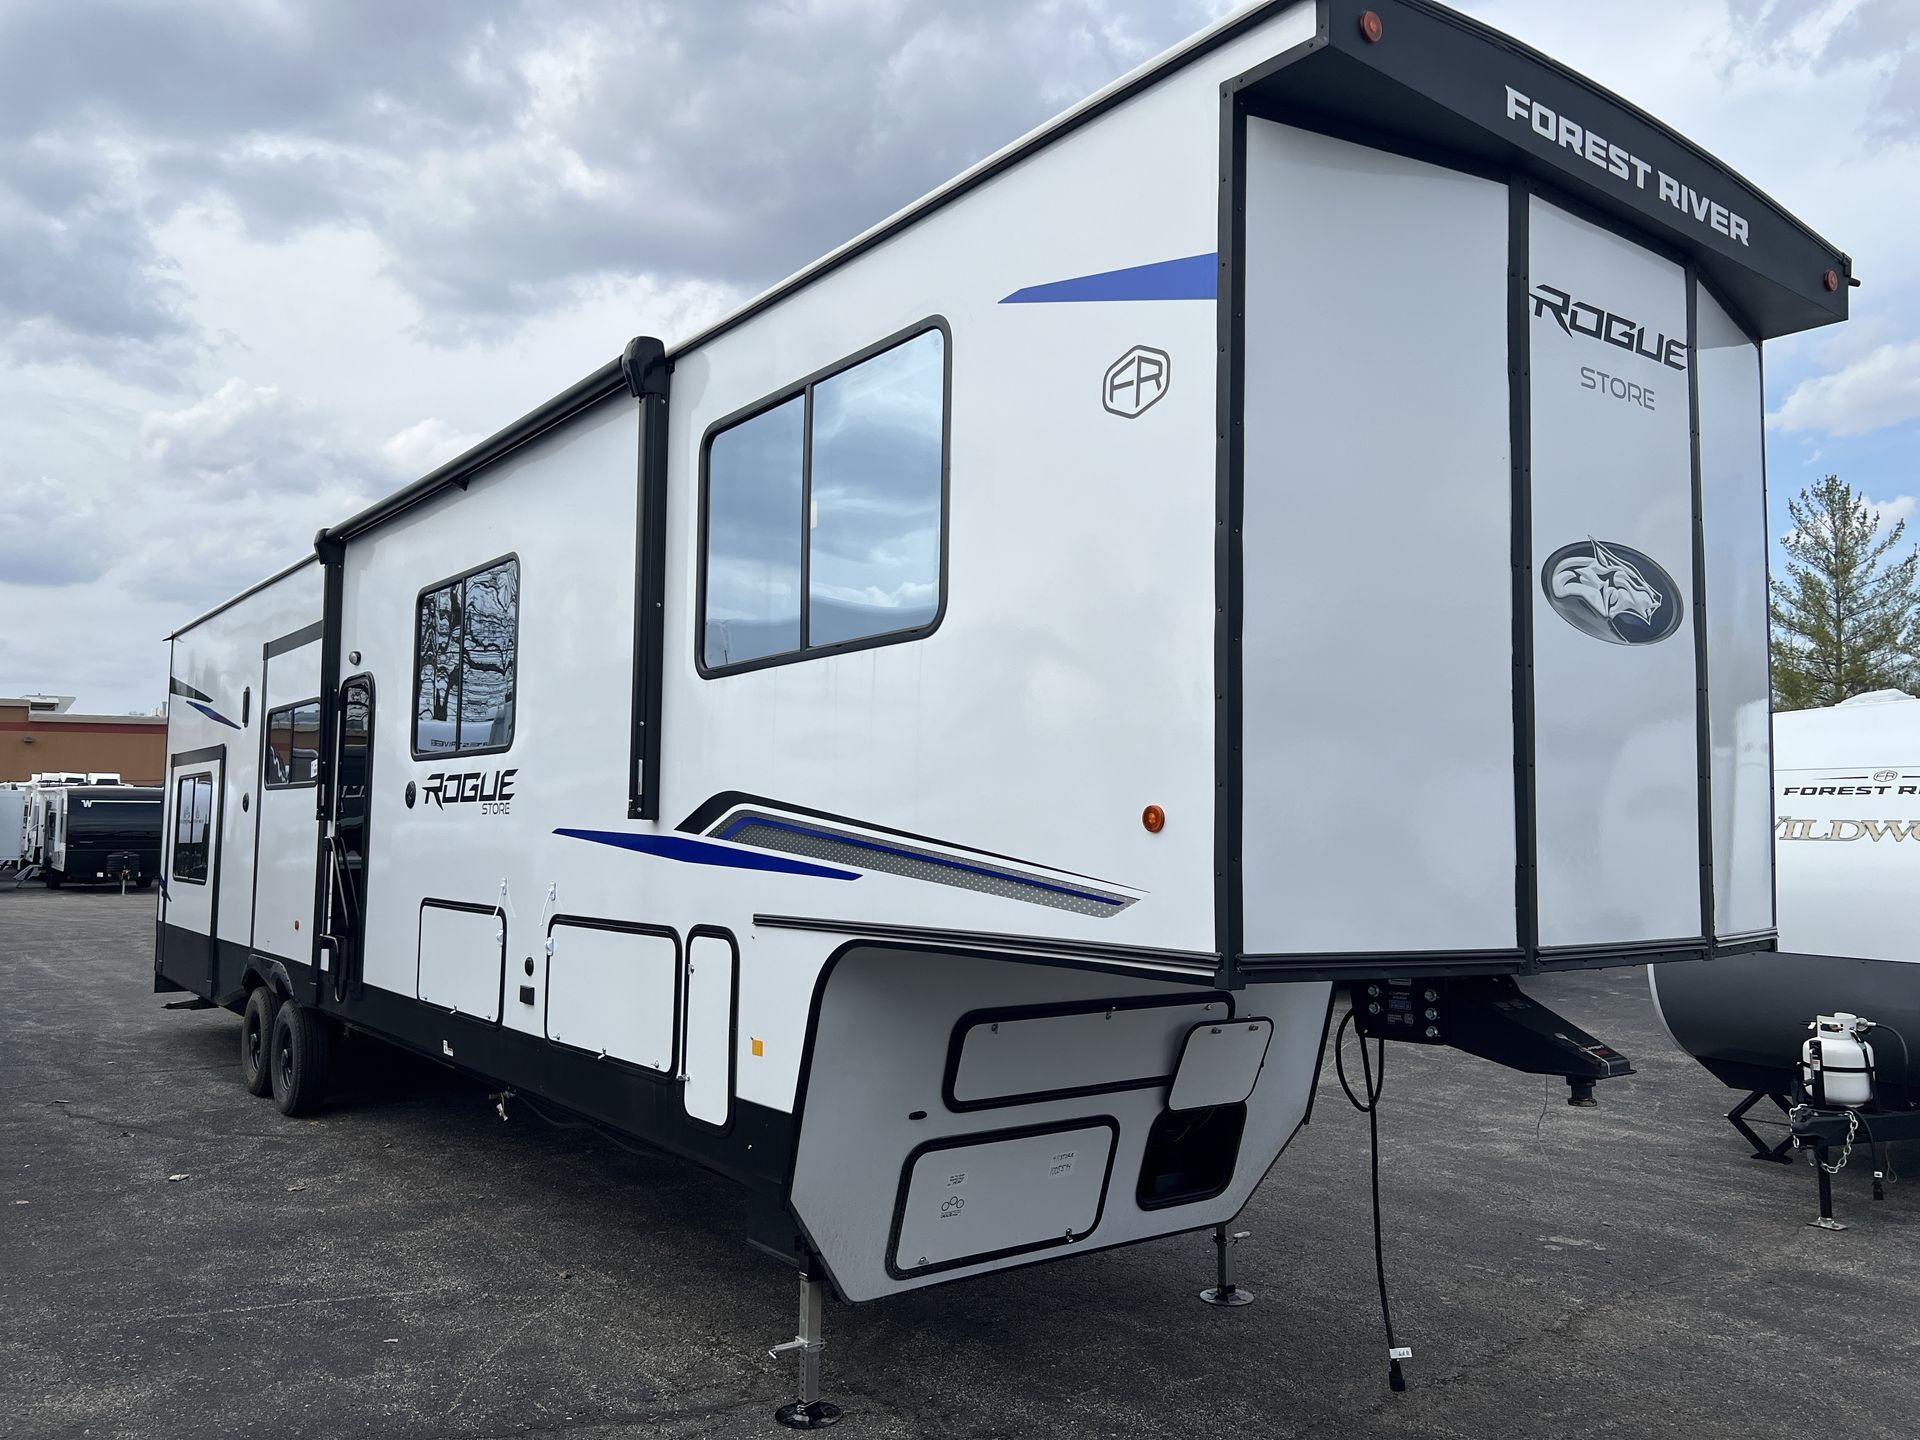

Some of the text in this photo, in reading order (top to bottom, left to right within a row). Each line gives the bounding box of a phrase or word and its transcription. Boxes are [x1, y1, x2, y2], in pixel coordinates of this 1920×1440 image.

[1505, 84, 1750, 247] FOREST RIVER
[1529, 284, 1688, 372] ROGUE
[1580, 366, 1656, 412] STORE
[422, 768, 519, 811] ROGUE
[481, 802, 511, 816] STORE
[1783, 785, 1920, 796] FOREST R
